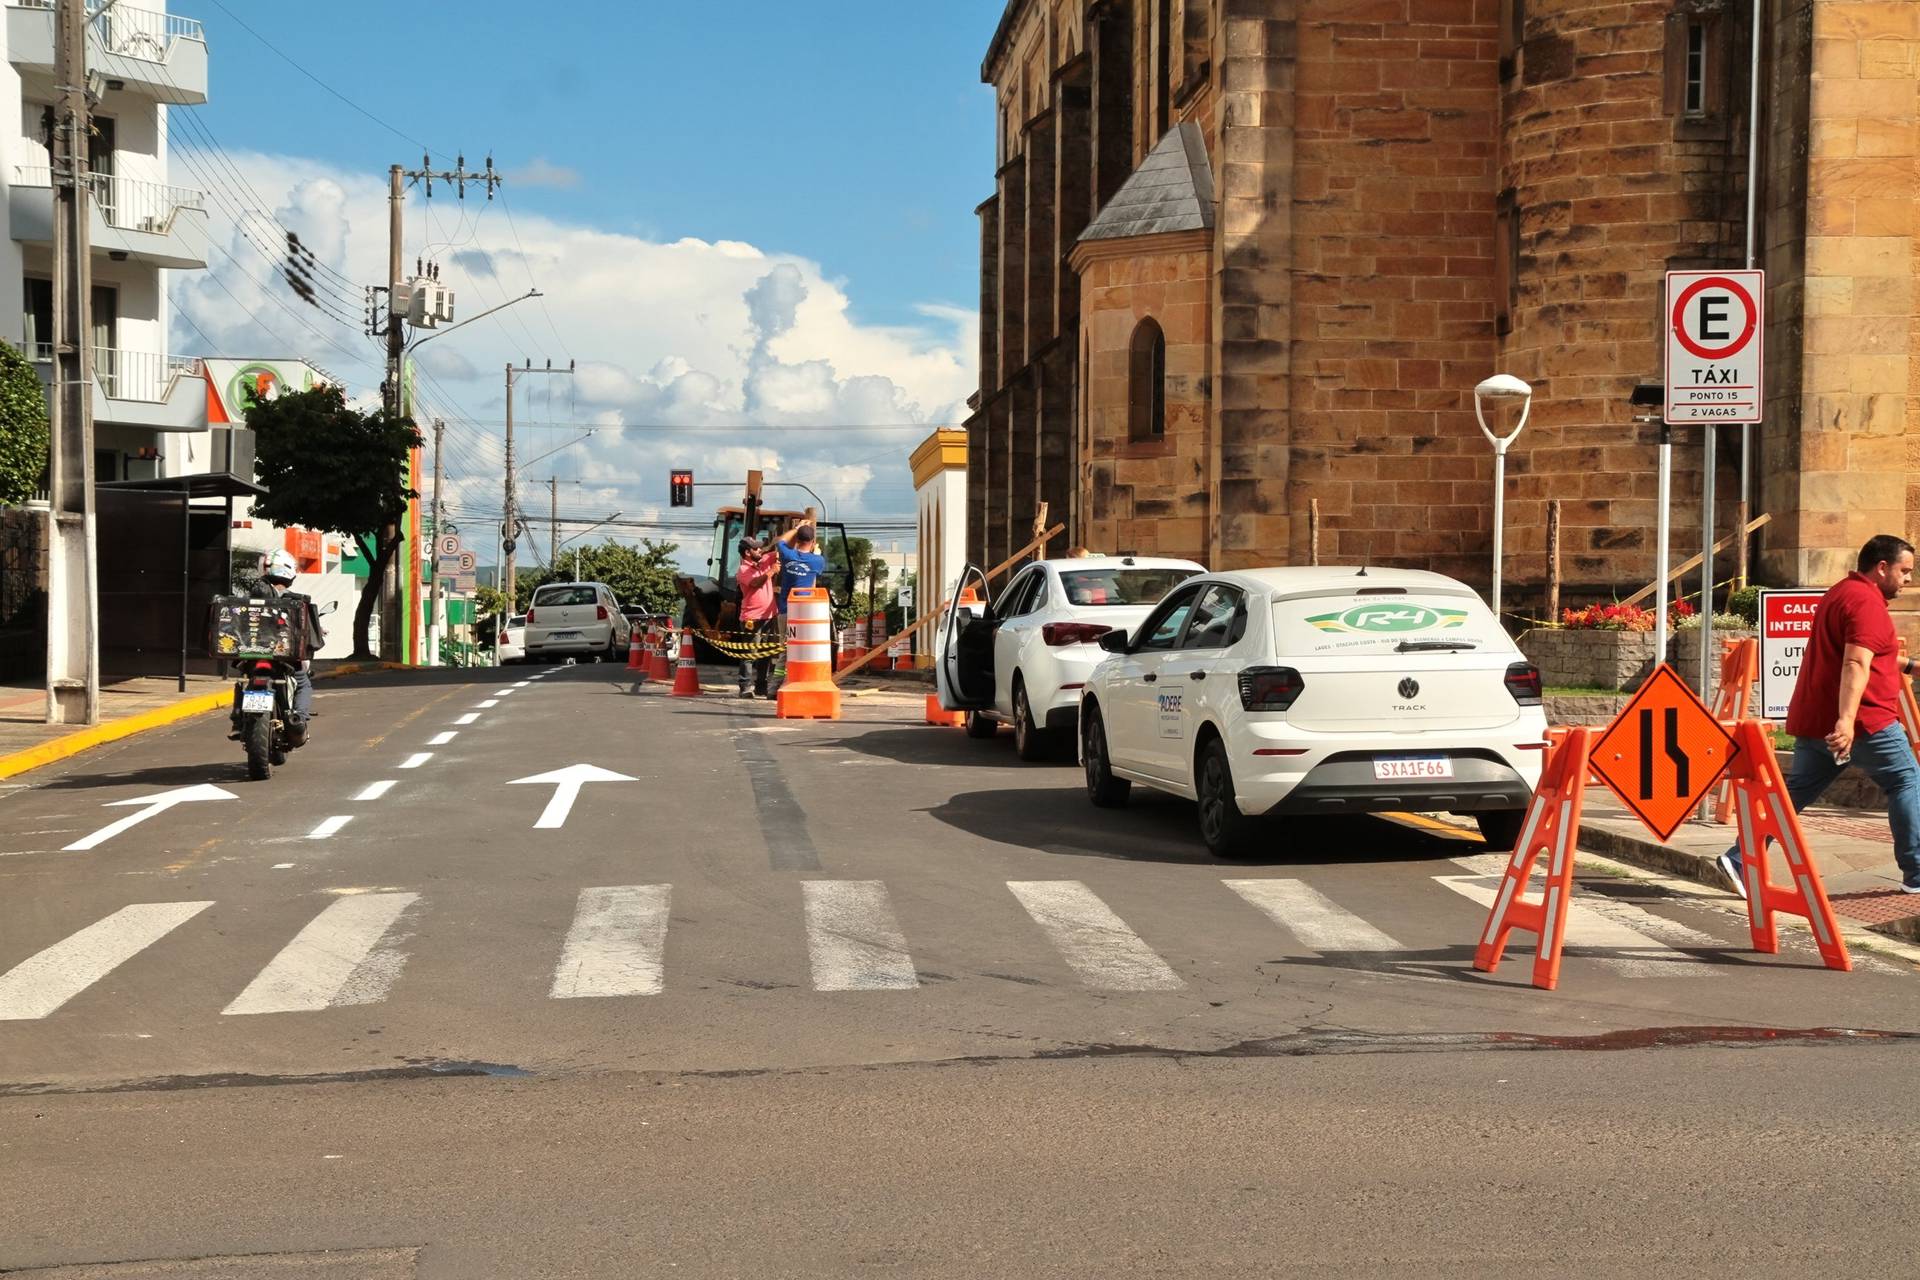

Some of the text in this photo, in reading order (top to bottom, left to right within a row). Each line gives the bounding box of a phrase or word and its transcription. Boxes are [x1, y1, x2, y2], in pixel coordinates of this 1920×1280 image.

[1699, 296, 1730, 340] E
[1691, 364, 1738, 384] TÁXI
[1689, 391, 1738, 400] PONTO 15
[1690, 408, 1737, 417] 2 VAGAS
[447, 541, 453, 551] E
[463, 557, 469, 567] E
[1772, 666, 1800, 677] OUT
[1381, 761, 1444, 776] SXA1F66
